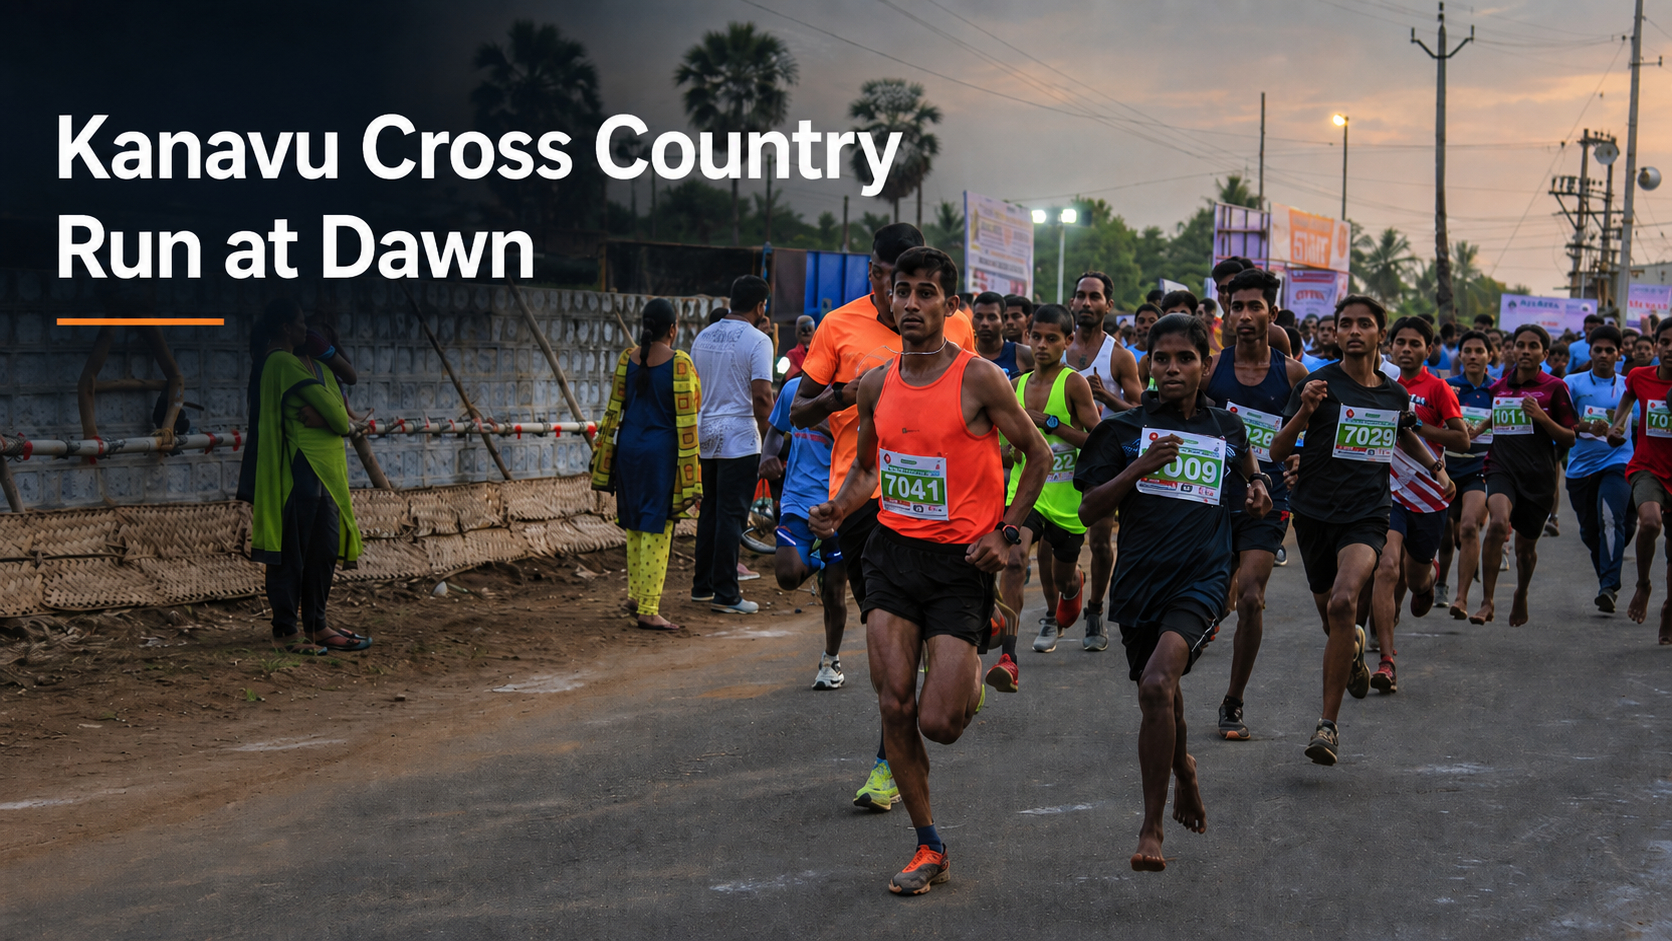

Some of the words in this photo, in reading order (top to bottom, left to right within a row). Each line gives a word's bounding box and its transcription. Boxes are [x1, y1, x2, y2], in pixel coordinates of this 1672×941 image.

[1495, 409, 1526, 424] 1011
[1650, 413, 1672, 428] 70
[1344, 425, 1394, 447] 7029
[1153, 455, 1217, 483] 009
[884, 473, 939, 501] 7041
